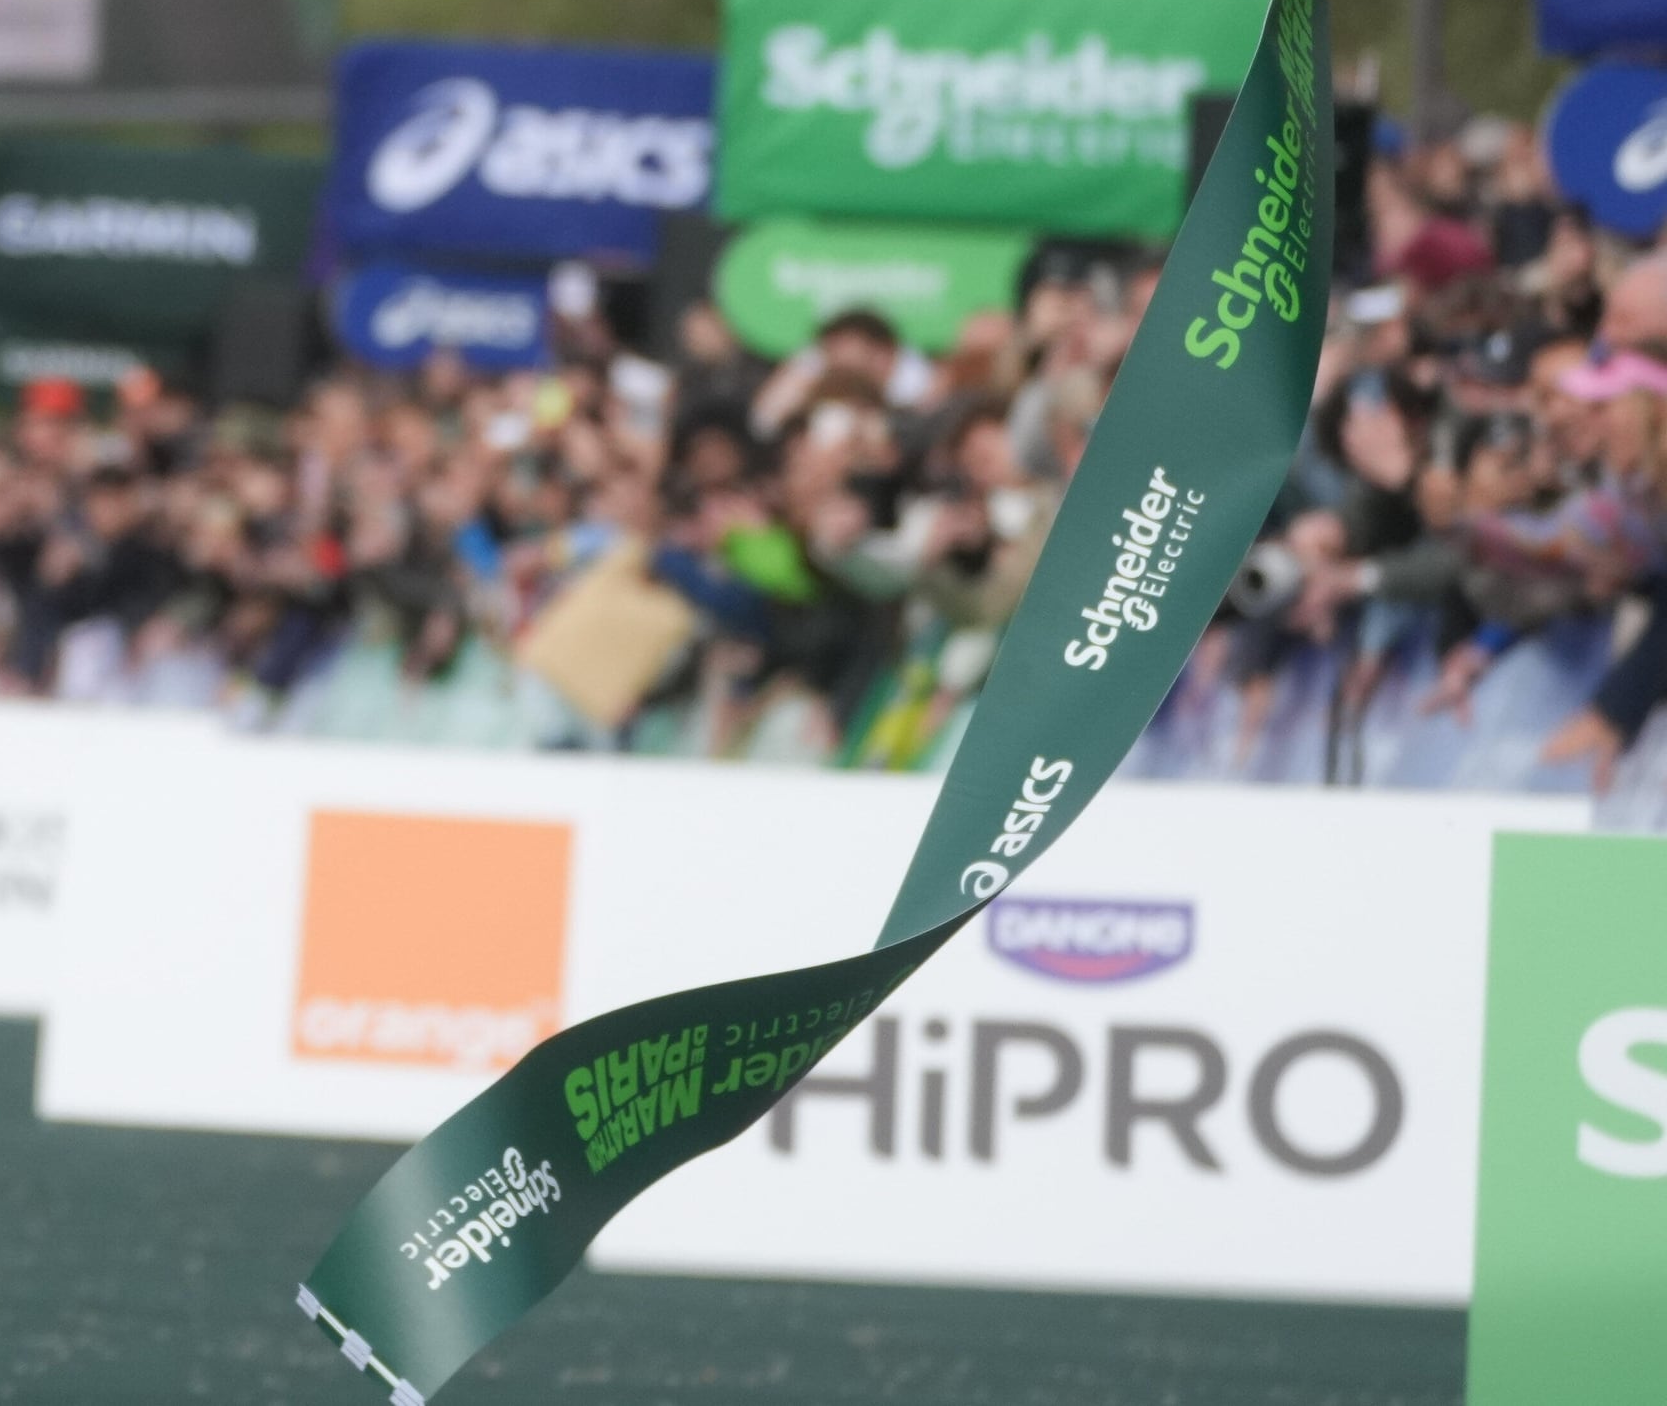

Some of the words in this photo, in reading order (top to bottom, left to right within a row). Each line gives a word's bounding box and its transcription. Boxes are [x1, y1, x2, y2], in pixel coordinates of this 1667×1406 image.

[762, 24, 1206, 120] Schneider
[1184, 91, 1302, 371] Schneider
[1064, 467, 1178, 671] Schneider
[1139, 488, 1205, 598] Electric
[991, 756, 1073, 857] asics
[302, 996, 535, 1072] orange
[565, 1028, 691, 1141] PARIS
[767, 1016, 1407, 1178] HiPRO
[400, 1167, 509, 1260] Electric
[424, 1160, 561, 1291] Schneider
